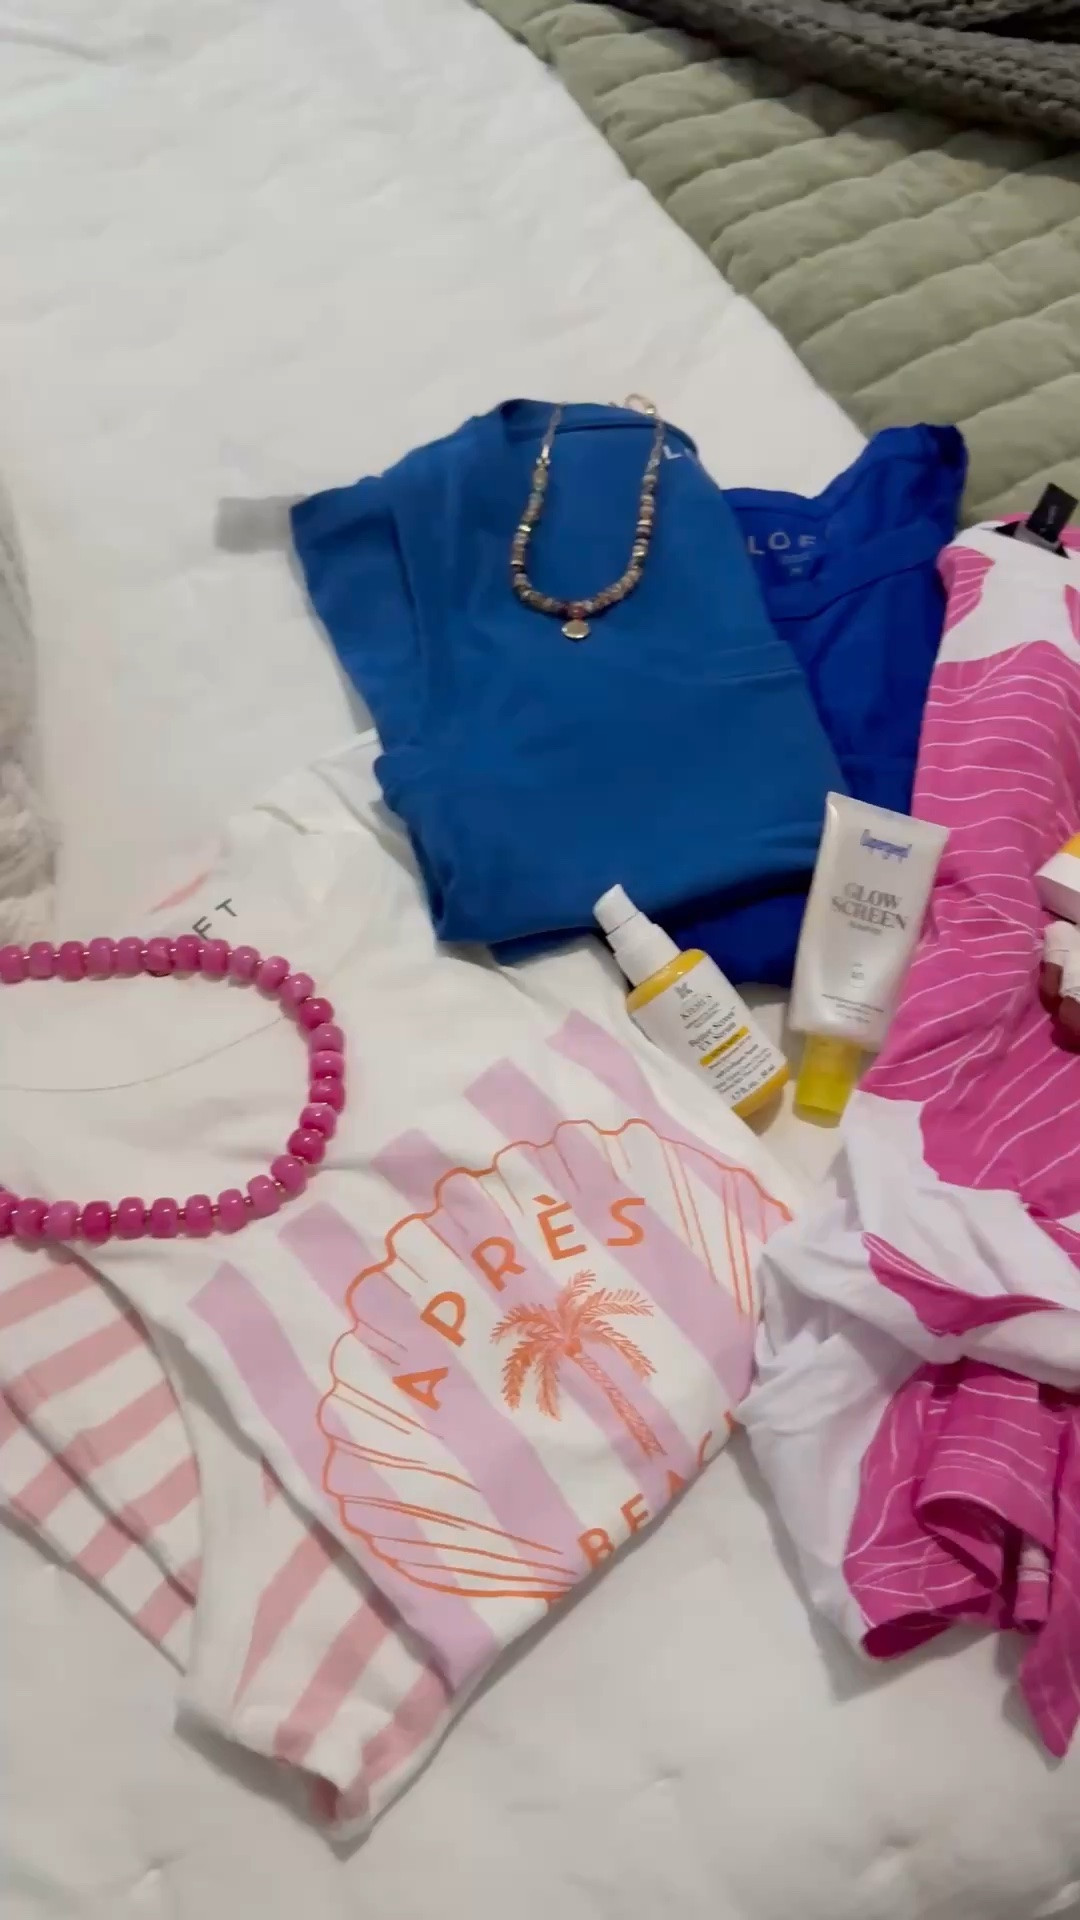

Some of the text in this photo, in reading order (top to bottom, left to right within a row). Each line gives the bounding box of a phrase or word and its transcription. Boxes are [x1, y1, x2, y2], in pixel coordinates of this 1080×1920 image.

[832, 896, 909, 930] SCREEN
[844, 882, 902, 910] GLOW
[392, 1195, 645, 1412] APRÈS
